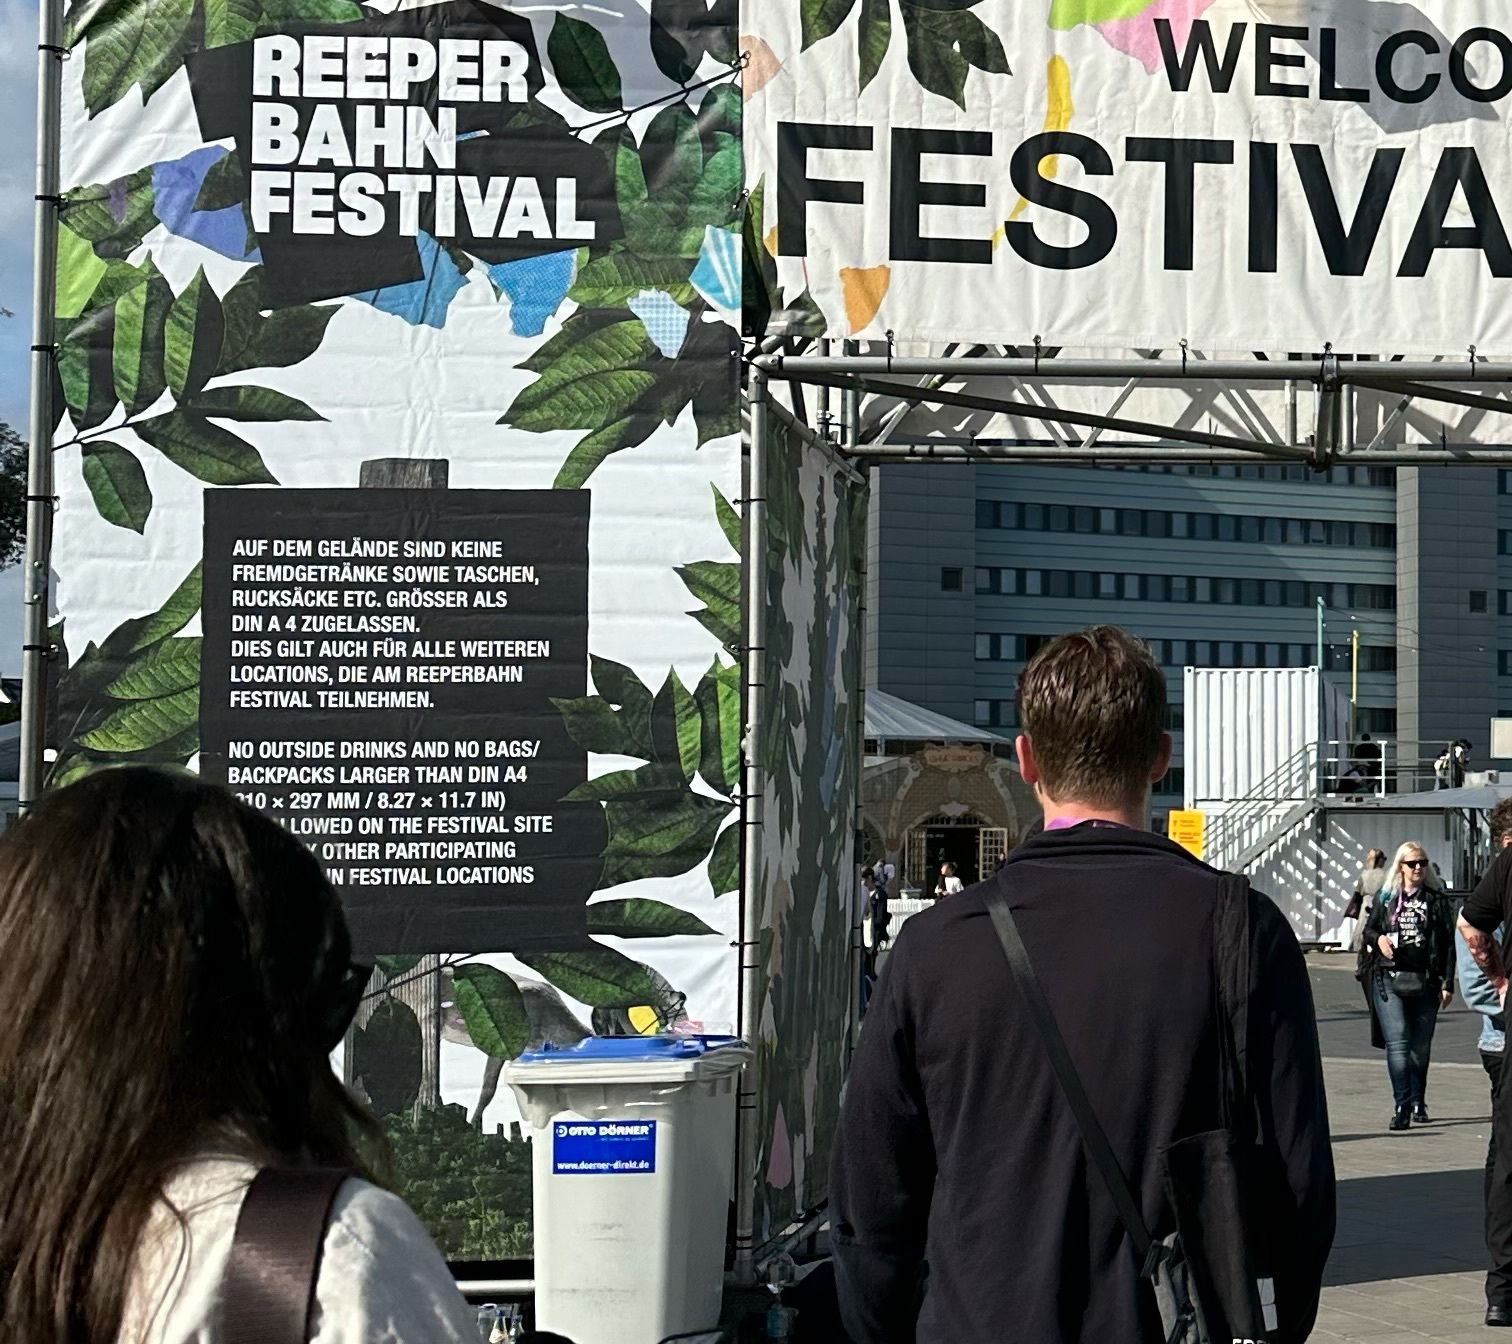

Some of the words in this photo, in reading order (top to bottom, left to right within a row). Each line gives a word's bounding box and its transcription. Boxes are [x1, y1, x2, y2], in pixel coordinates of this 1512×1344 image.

[253, 35, 529, 103] REEPER
[251, 102, 458, 169] BAHN
[251, 172, 596, 240] FESTIVAL
[233, 540, 268, 557] AUF
[273, 540, 312, 557] DEM
[318, 537, 398, 557] GELÄNDE
[404, 540, 445, 557] SIND
[452, 540, 502, 557] KEINE
[233, 562, 387, 583] FREMDGETRÄNKE
[393, 565, 449, 583] SOWIE
[454, 565, 539, 585] TASCHEN,
[232, 587, 338, 607] RUCKSÄCKE
[344, 591, 381, 607] ETC.
[387, 588, 467, 607] GRÖSSER
[473, 591, 507, 607] ALS
[232, 615, 262, 632] DIN
[268, 615, 280, 632] A
[285, 615, 296, 632] 4
[301, 615, 420, 632] ZUGELASSEN.
[231, 640, 272, 657] DIES
[277, 640, 314, 657] GILT
[319, 640, 367, 657] AUCH
[373, 638, 406, 657] FÜR
[412, 640, 455, 657] ALLE
[461, 640, 550, 657] WEITEREN
[230, 666, 333, 685] LOCATIONS,
[339, 666, 367, 683] DIE
[372, 666, 400, 683] AM
[407, 666, 522, 683] REEPERBAHN
[230, 690, 312, 708] FESTIVAL
[317, 690, 434, 708] TEILNEHMEN.
[229, 741, 253, 759] NO
[259, 741, 334, 758] OUTSIDE
[340, 741, 406, 758] DRINKS
[411, 741, 449, 758] AND
[455, 741, 479, 758] NO
[485, 740, 540, 758] BAGS/
[228, 767, 334, 784] BACKPACKS
[340, 766, 409, 783] LARGER
[415, 766, 462, 783] THAN
[469, 766, 498, 783] DIN
[504, 766, 527, 783] A4
[289, 792, 322, 809] 297
[328, 792, 359, 809] MM
[365, 792, 373, 809] /
[378, 792, 415, 809] 8.27
[439, 792, 476, 808] 11.7
[482, 791, 505, 811] IN)
[359, 817, 383, 834] ON
[388, 817, 422, 834] THE
[428, 816, 509, 834] FESTIVAL
[514, 816, 552, 833] SITE
[322, 843, 379, 859] OTHER
[385, 841, 516, 859] PARTICIPATING
[350, 867, 431, 885] FESTIVAL
[437, 866, 534, 884] LOCATIONS
[569, 1126, 597, 1136] OTTO
[599, 1124, 650, 1136] DÖRNER
[557, 1159, 650, 1170] www.doerner-direkt.de
